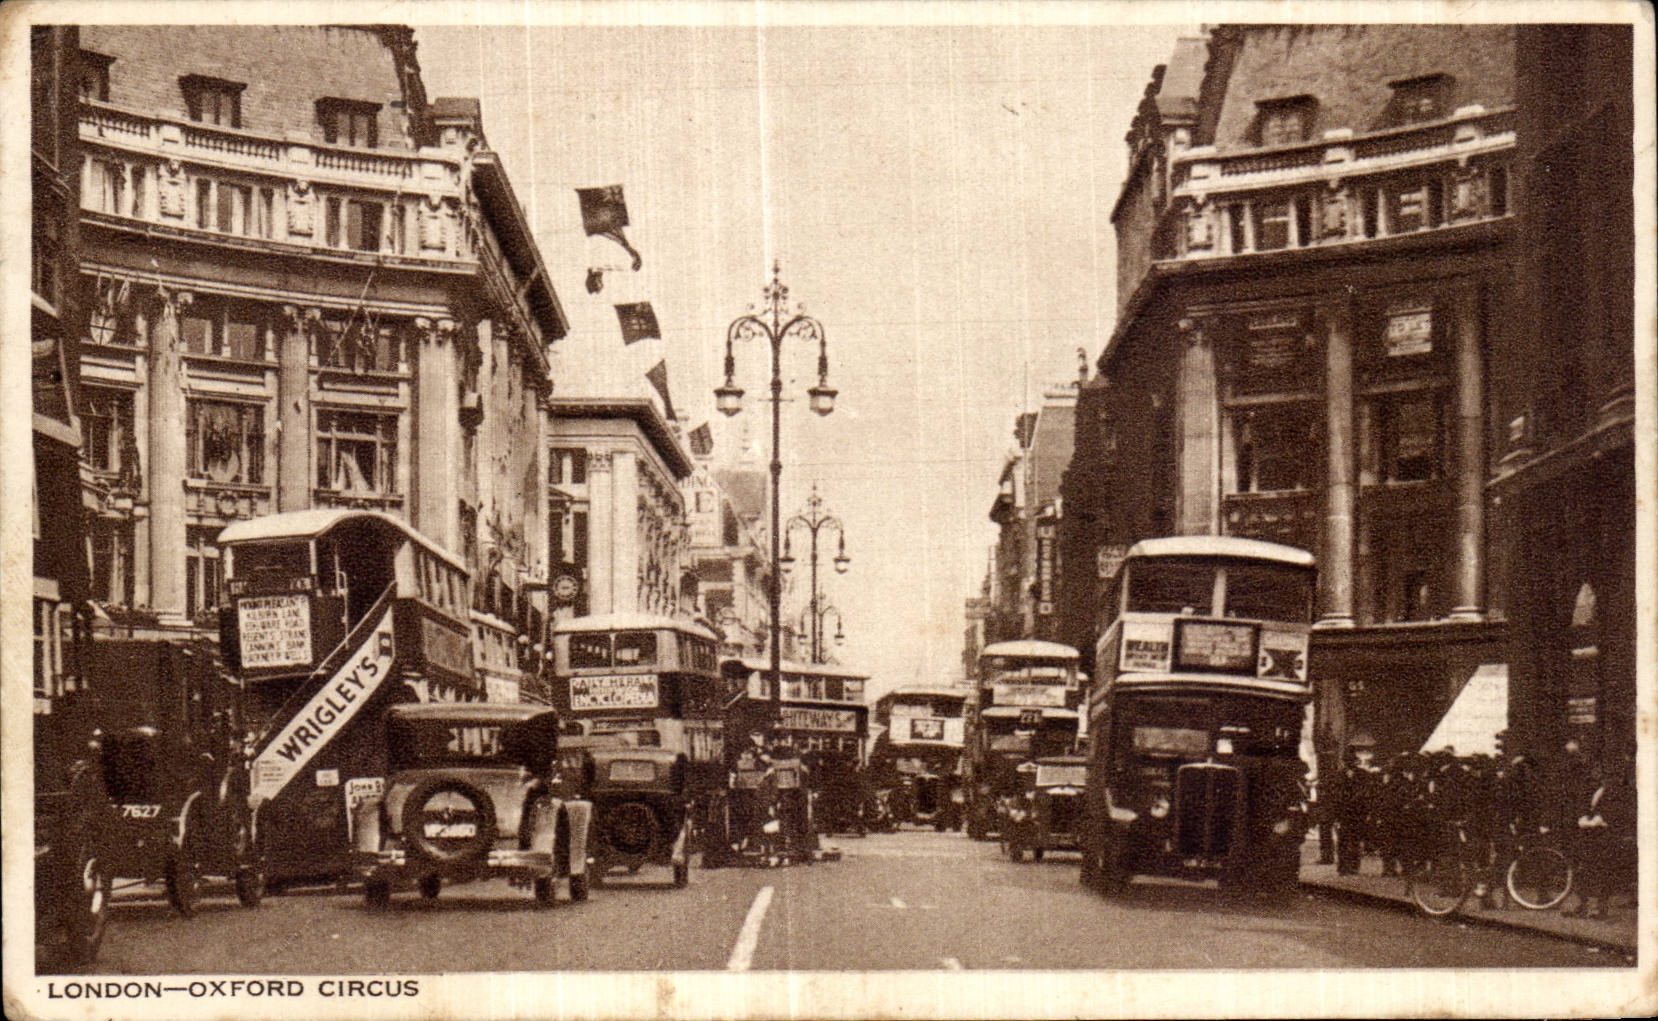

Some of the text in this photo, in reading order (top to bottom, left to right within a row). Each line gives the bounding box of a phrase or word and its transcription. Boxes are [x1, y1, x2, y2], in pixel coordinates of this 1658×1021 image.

[572, 679, 603, 689] DAILY
[276, 656, 379, 762] WRIGLEY'S
[121, 804, 161, 818] 7627
